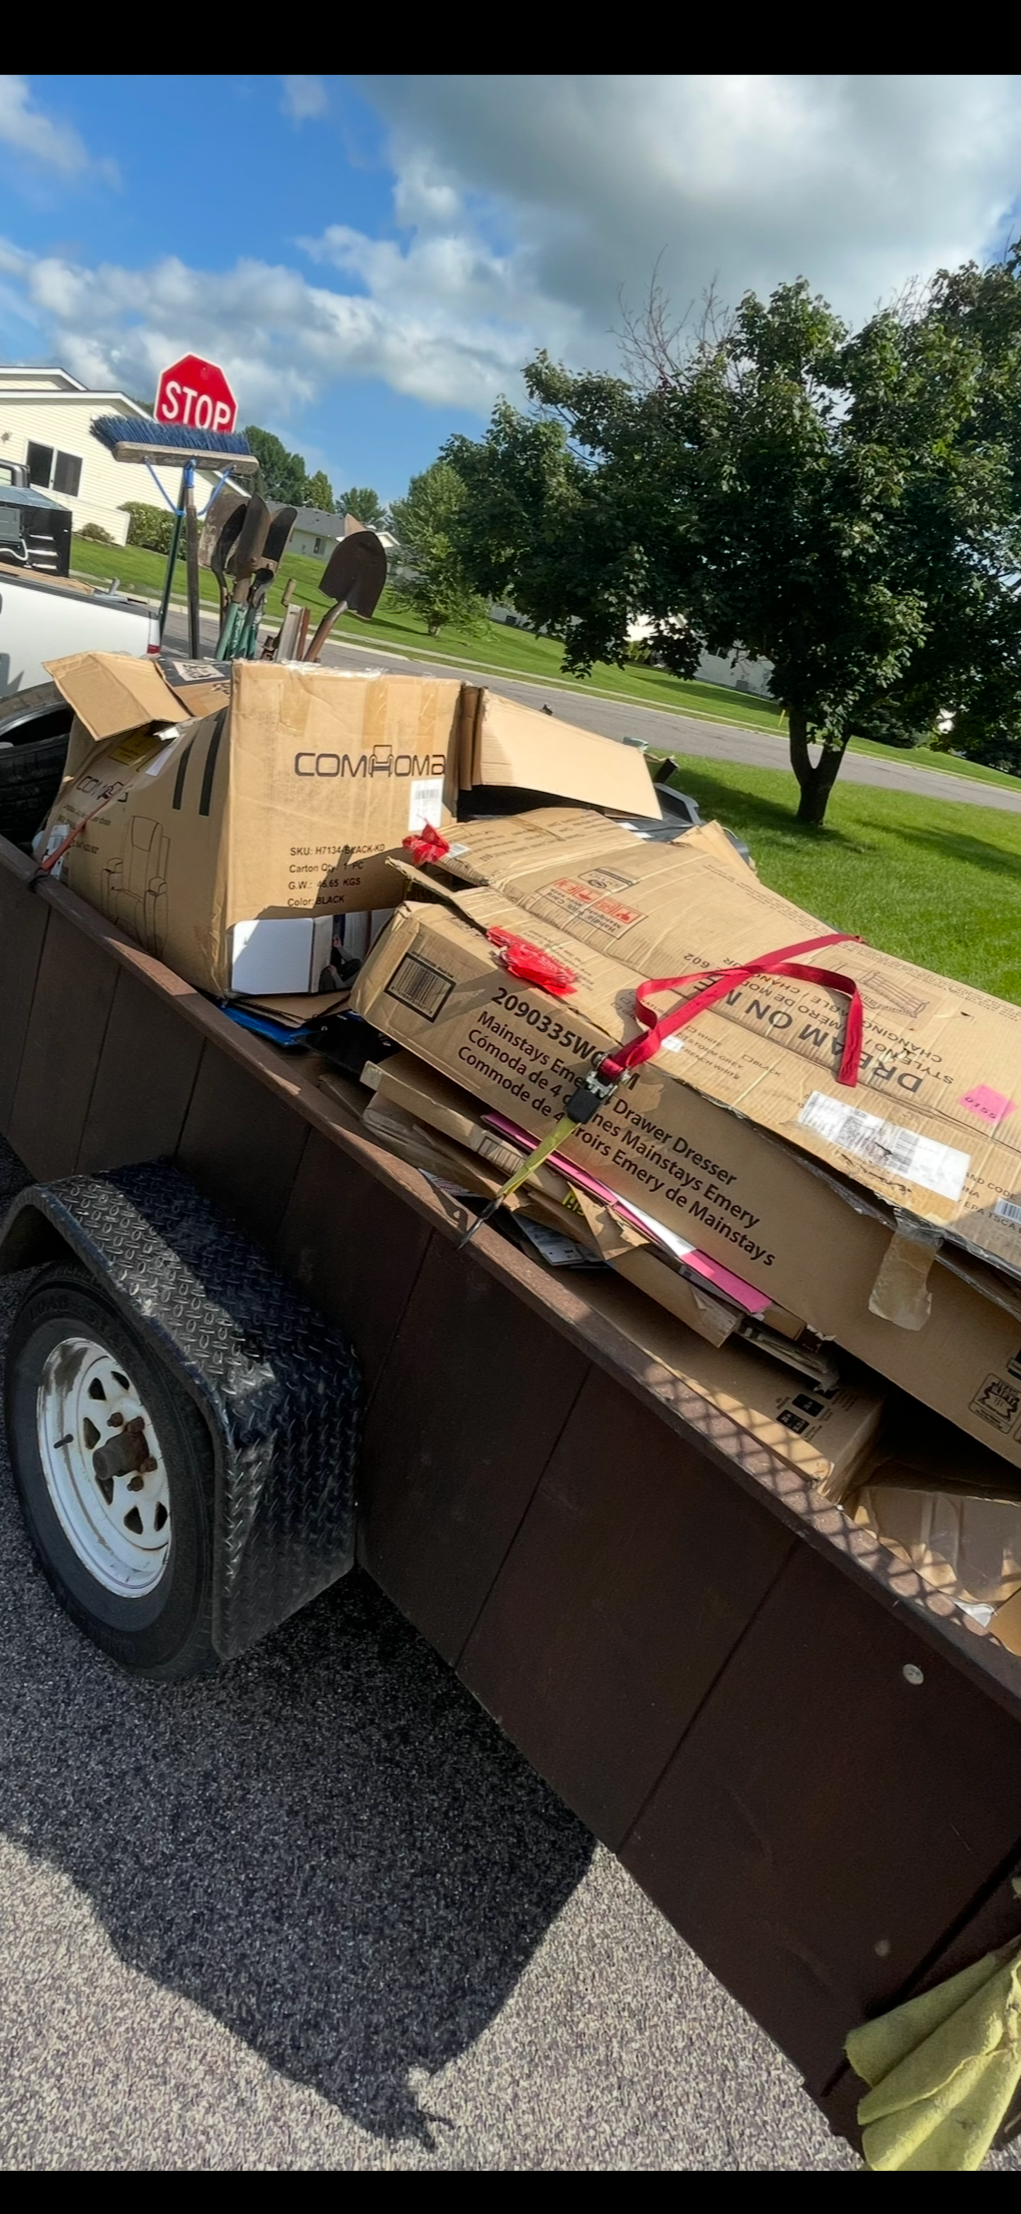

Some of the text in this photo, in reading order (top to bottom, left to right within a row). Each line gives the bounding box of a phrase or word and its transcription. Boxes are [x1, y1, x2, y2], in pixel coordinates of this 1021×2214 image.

[161, 380, 232, 432] STOP
[290, 845, 313, 857] SKU:
[289, 864, 319, 874] Carton
[343, 861, 348, 871] 1
[352, 860, 365, 871] PC
[343, 877, 361, 887] KGS
[287, 894, 346, 908] Color: BLACK
[683, 952, 711, 969] 602
[775, 993, 796, 1008] DE
[811, 995, 849, 1017] ABLE
[746, 998, 793, 1029] ON
[797, 1005, 846, 1031] MÉRO
[697, 1030, 724, 1049] WHITE
[862, 1020, 943, 1063] CHANGING
[683, 1047, 714, 1069] RENCH
[686, 1035, 744, 1070] STORM GREY
[798, 1024, 924, 1093] DREAM
[752, 1059, 783, 1078] BLACK
[900, 1055, 955, 1085] STYLE
[477, 1010, 551, 1067] Mainstays
[613, 1098, 673, 1146] Drawer
[672, 1137, 738, 1186] Dresser
[467, 1029, 528, 1076] Cómoda
[528, 1068, 549, 1092] de
[549, 1084, 563, 1098] 4
[622, 1129, 701, 1191] Mainstays
[703, 1184, 761, 1230] Emery
[457, 1046, 777, 1268] Commode de 4 roirs Emery de Mainstays
[987, 1182, 1017, 1201] CODE
[964, 1200, 1017, 1230] EPA TSCA
